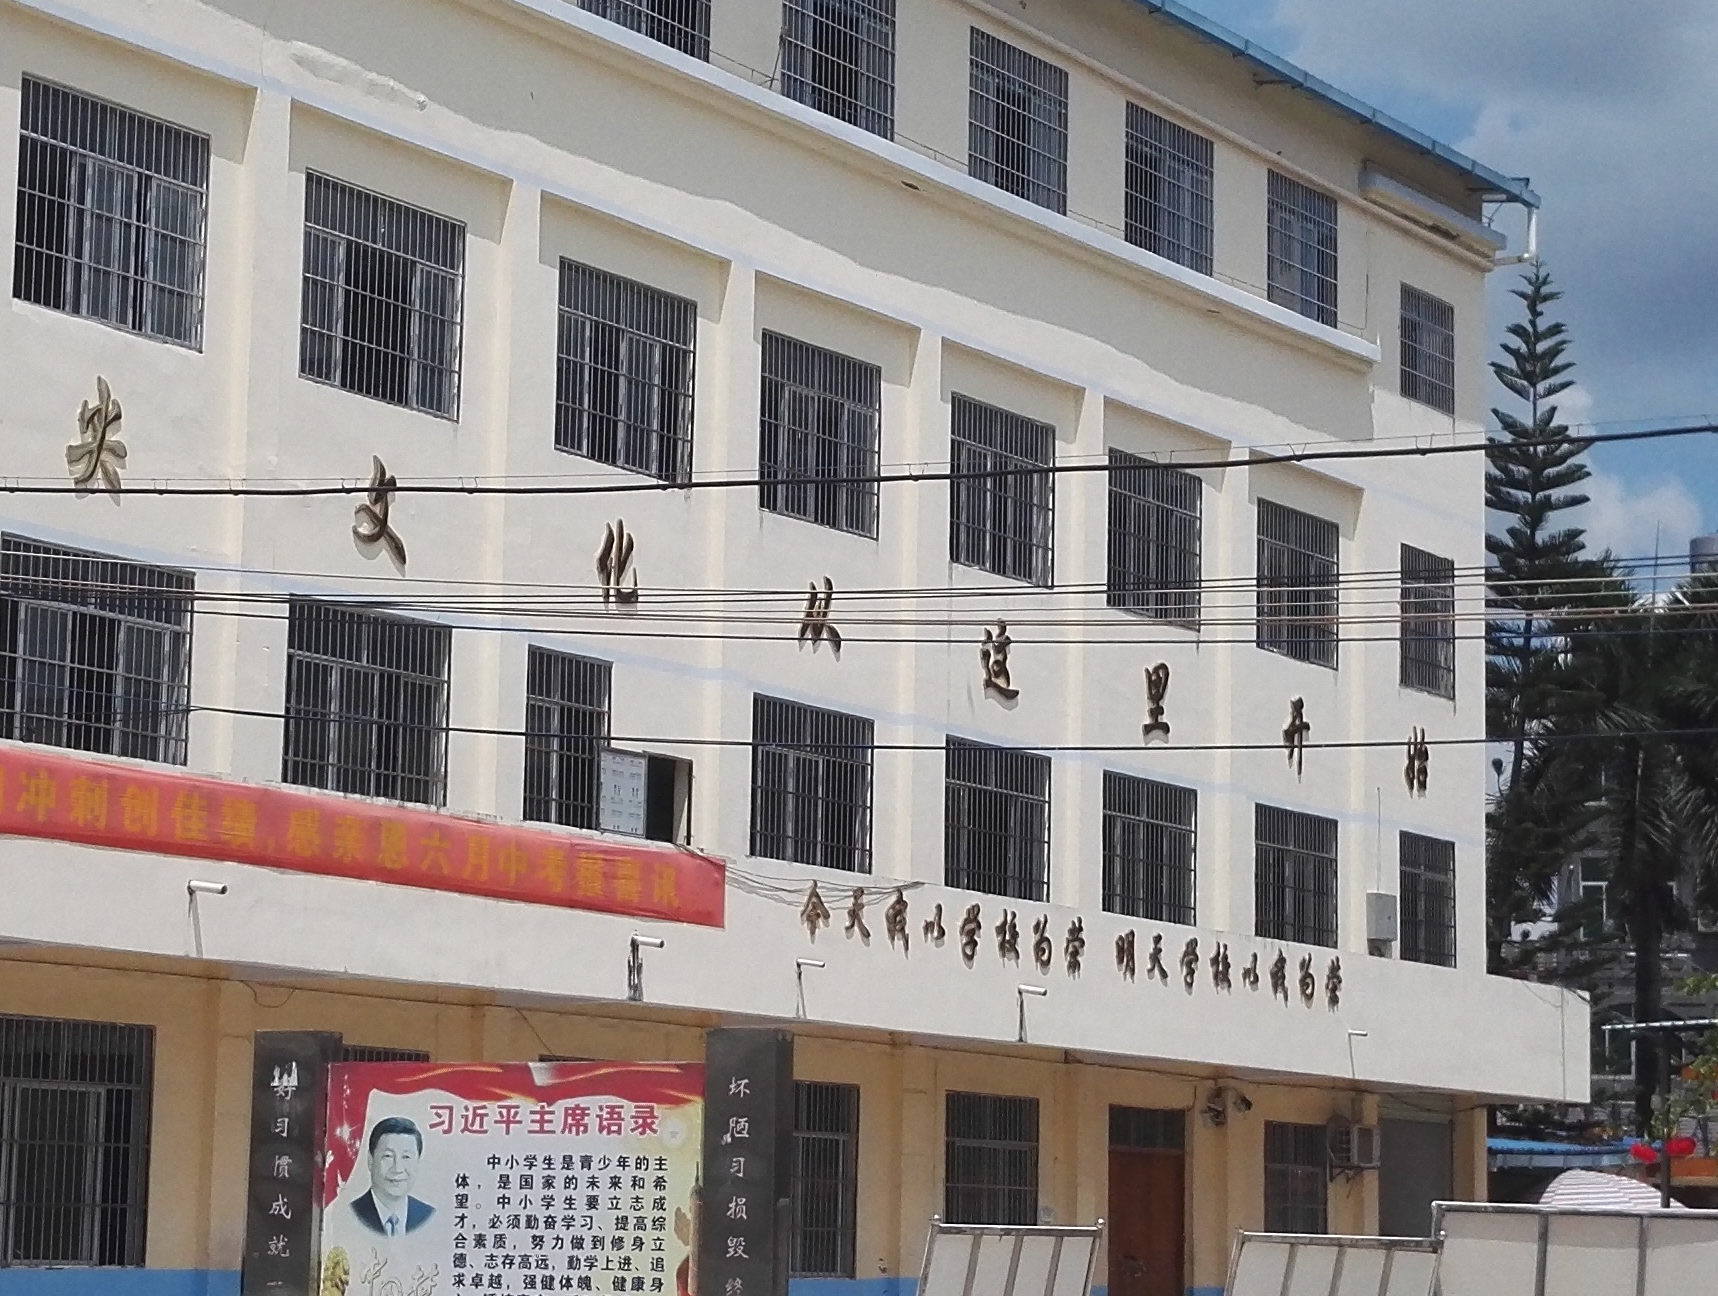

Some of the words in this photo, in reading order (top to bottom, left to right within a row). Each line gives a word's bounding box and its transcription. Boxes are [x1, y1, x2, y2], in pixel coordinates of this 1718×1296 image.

[799, 878, 1085, 977] 今天我以学校为荣
[1114, 929, 1343, 1010] 明天学校以我为荣
[428, 1103, 660, 1137] 习近平主席语录
[486, 1154, 668, 1172] 中小学生是青少年的主
[454, 1173, 668, 1191] 体，是国家的未来和希
[453, 1193, 667, 1212] 望。中小学生要立志成
[453, 1213, 667, 1232] 才，必须勤奋学习、提高综
[452, 1233, 666, 1252] 合素质，努力做到修身立
[452, 1253, 665, 1272] 德、志存高远，勤学上进、追
[451, 1273, 665, 1293] 求卓越，强健体魄、健康身
